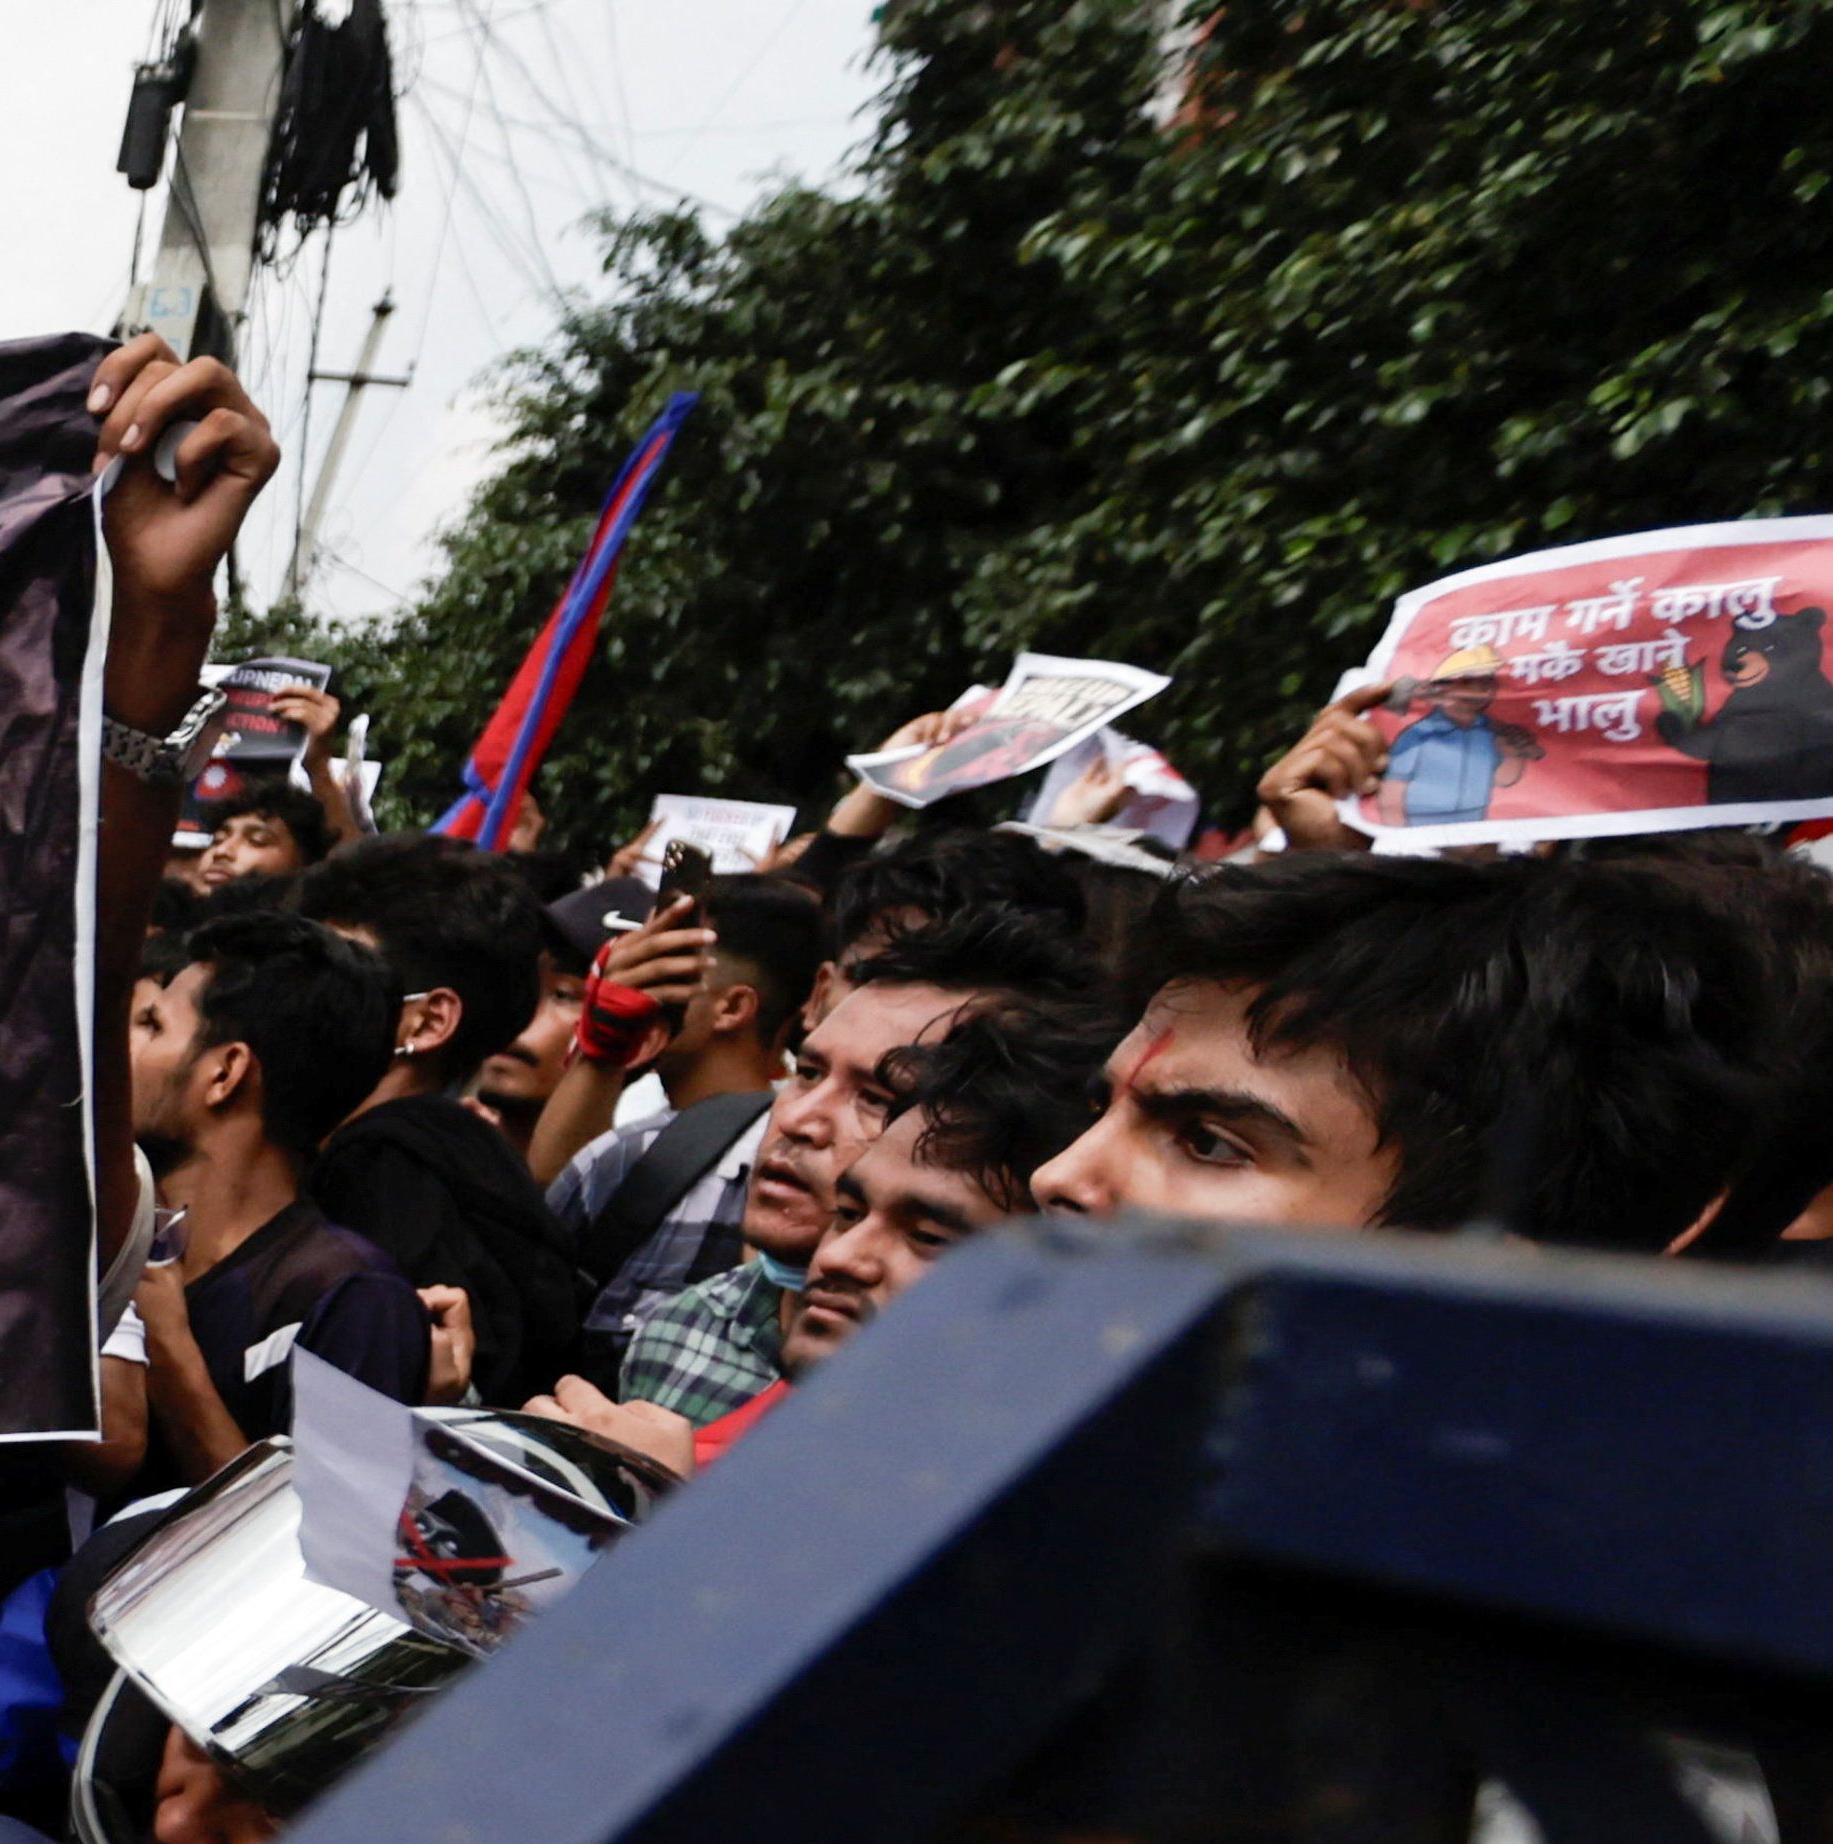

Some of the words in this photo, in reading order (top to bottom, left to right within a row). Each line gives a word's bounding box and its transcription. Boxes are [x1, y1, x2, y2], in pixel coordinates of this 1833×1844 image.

[1447, 603, 1558, 650] काम
[1648, 576, 1785, 631] कालु
[1595, 628, 1692, 677] खाने
[1531, 688, 1648, 741] भालु
